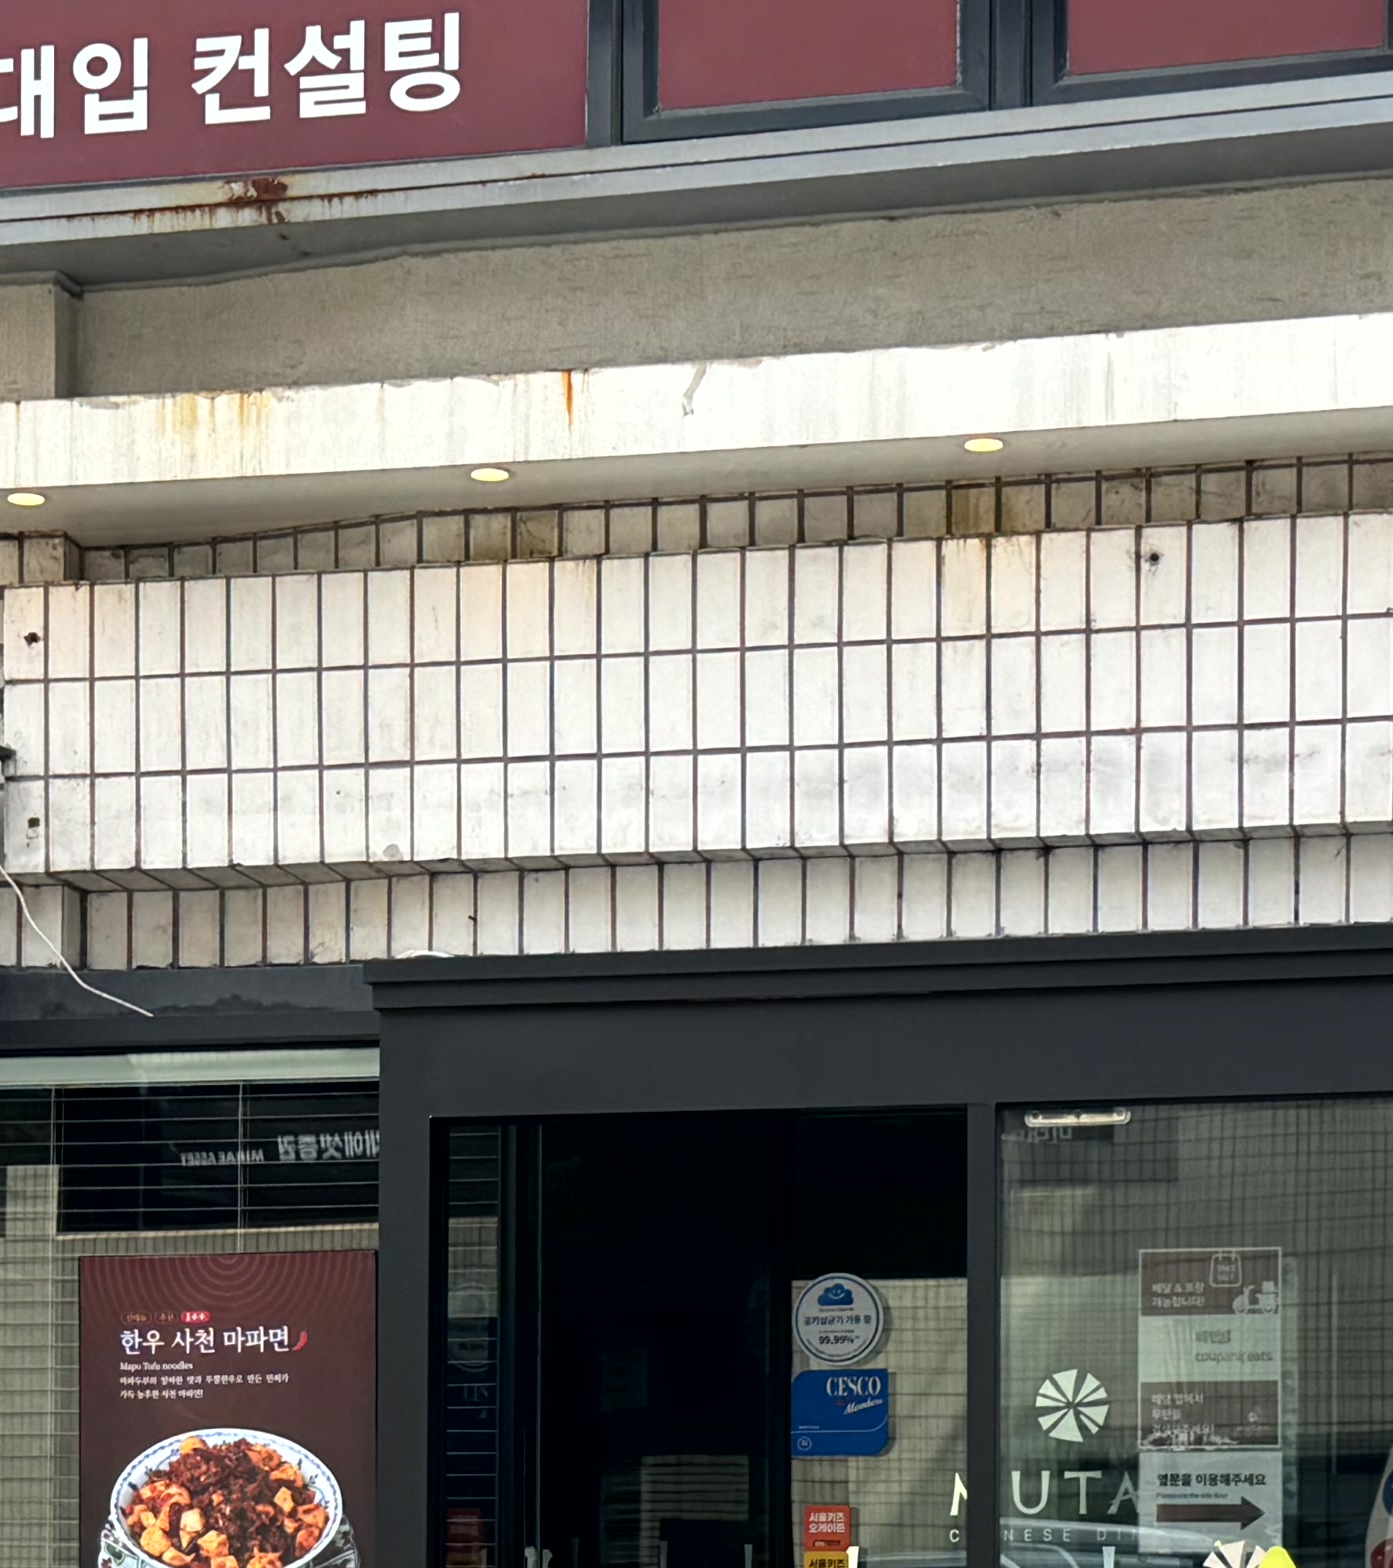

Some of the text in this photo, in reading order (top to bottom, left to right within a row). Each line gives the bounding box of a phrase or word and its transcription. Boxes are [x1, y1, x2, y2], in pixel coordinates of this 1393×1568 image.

[191, 11, 461, 126] 컨설팅
[120, 1326, 289, 1354] 한우 사천 마파면
[120, 1361, 193, 1372] Mapo Tofu noodles
[827, 1376, 881, 1396] CESCO
[1196, 1473, 1266, 1486] 이용해주세요
